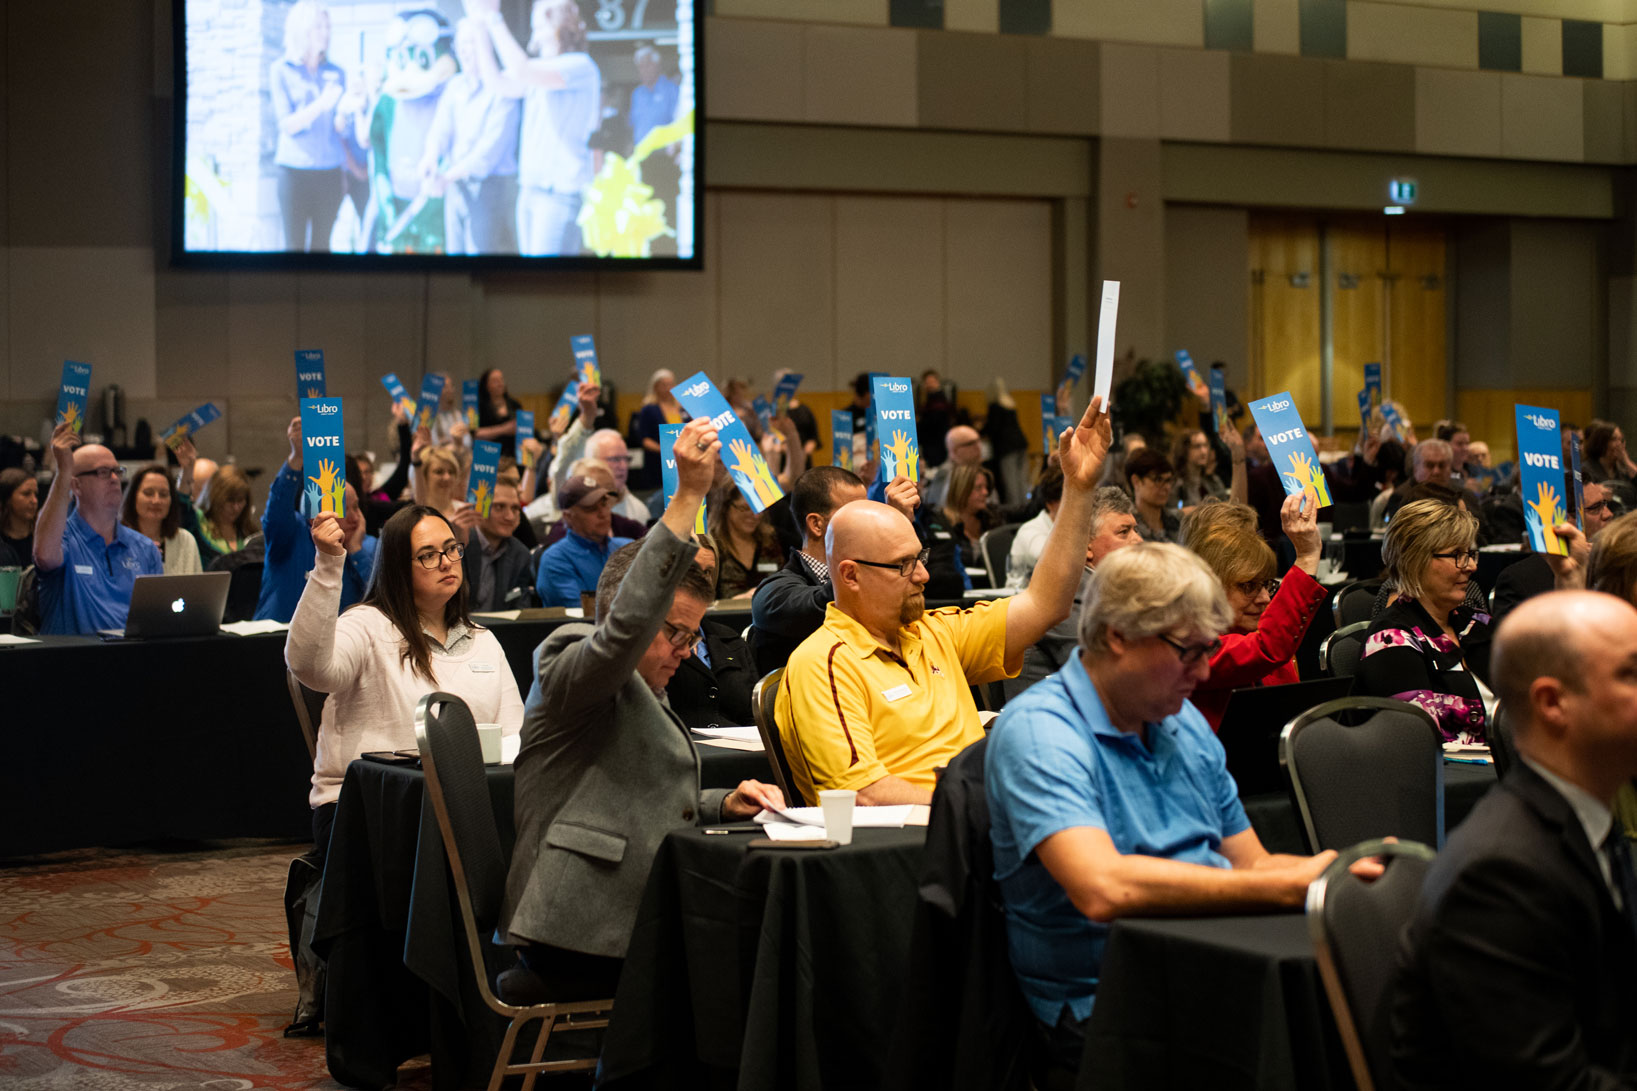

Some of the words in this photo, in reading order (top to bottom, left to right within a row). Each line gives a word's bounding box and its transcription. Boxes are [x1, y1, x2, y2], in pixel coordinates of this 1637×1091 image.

[300, 372, 323, 381] VOTE
[63, 385, 86, 397] VOTE
[888, 382, 908, 392] Libro
[317, 404, 338, 414] Libro
[1267, 400, 1290, 412] Libro
[881, 410, 911, 420] VOTE
[1533, 414, 1556, 429] Libro
[307, 436, 340, 447] VOTE
[1268, 427, 1304, 446] VOTE
[1524, 452, 1560, 470] VOTE
[474, 463, 496, 474] VOTE
